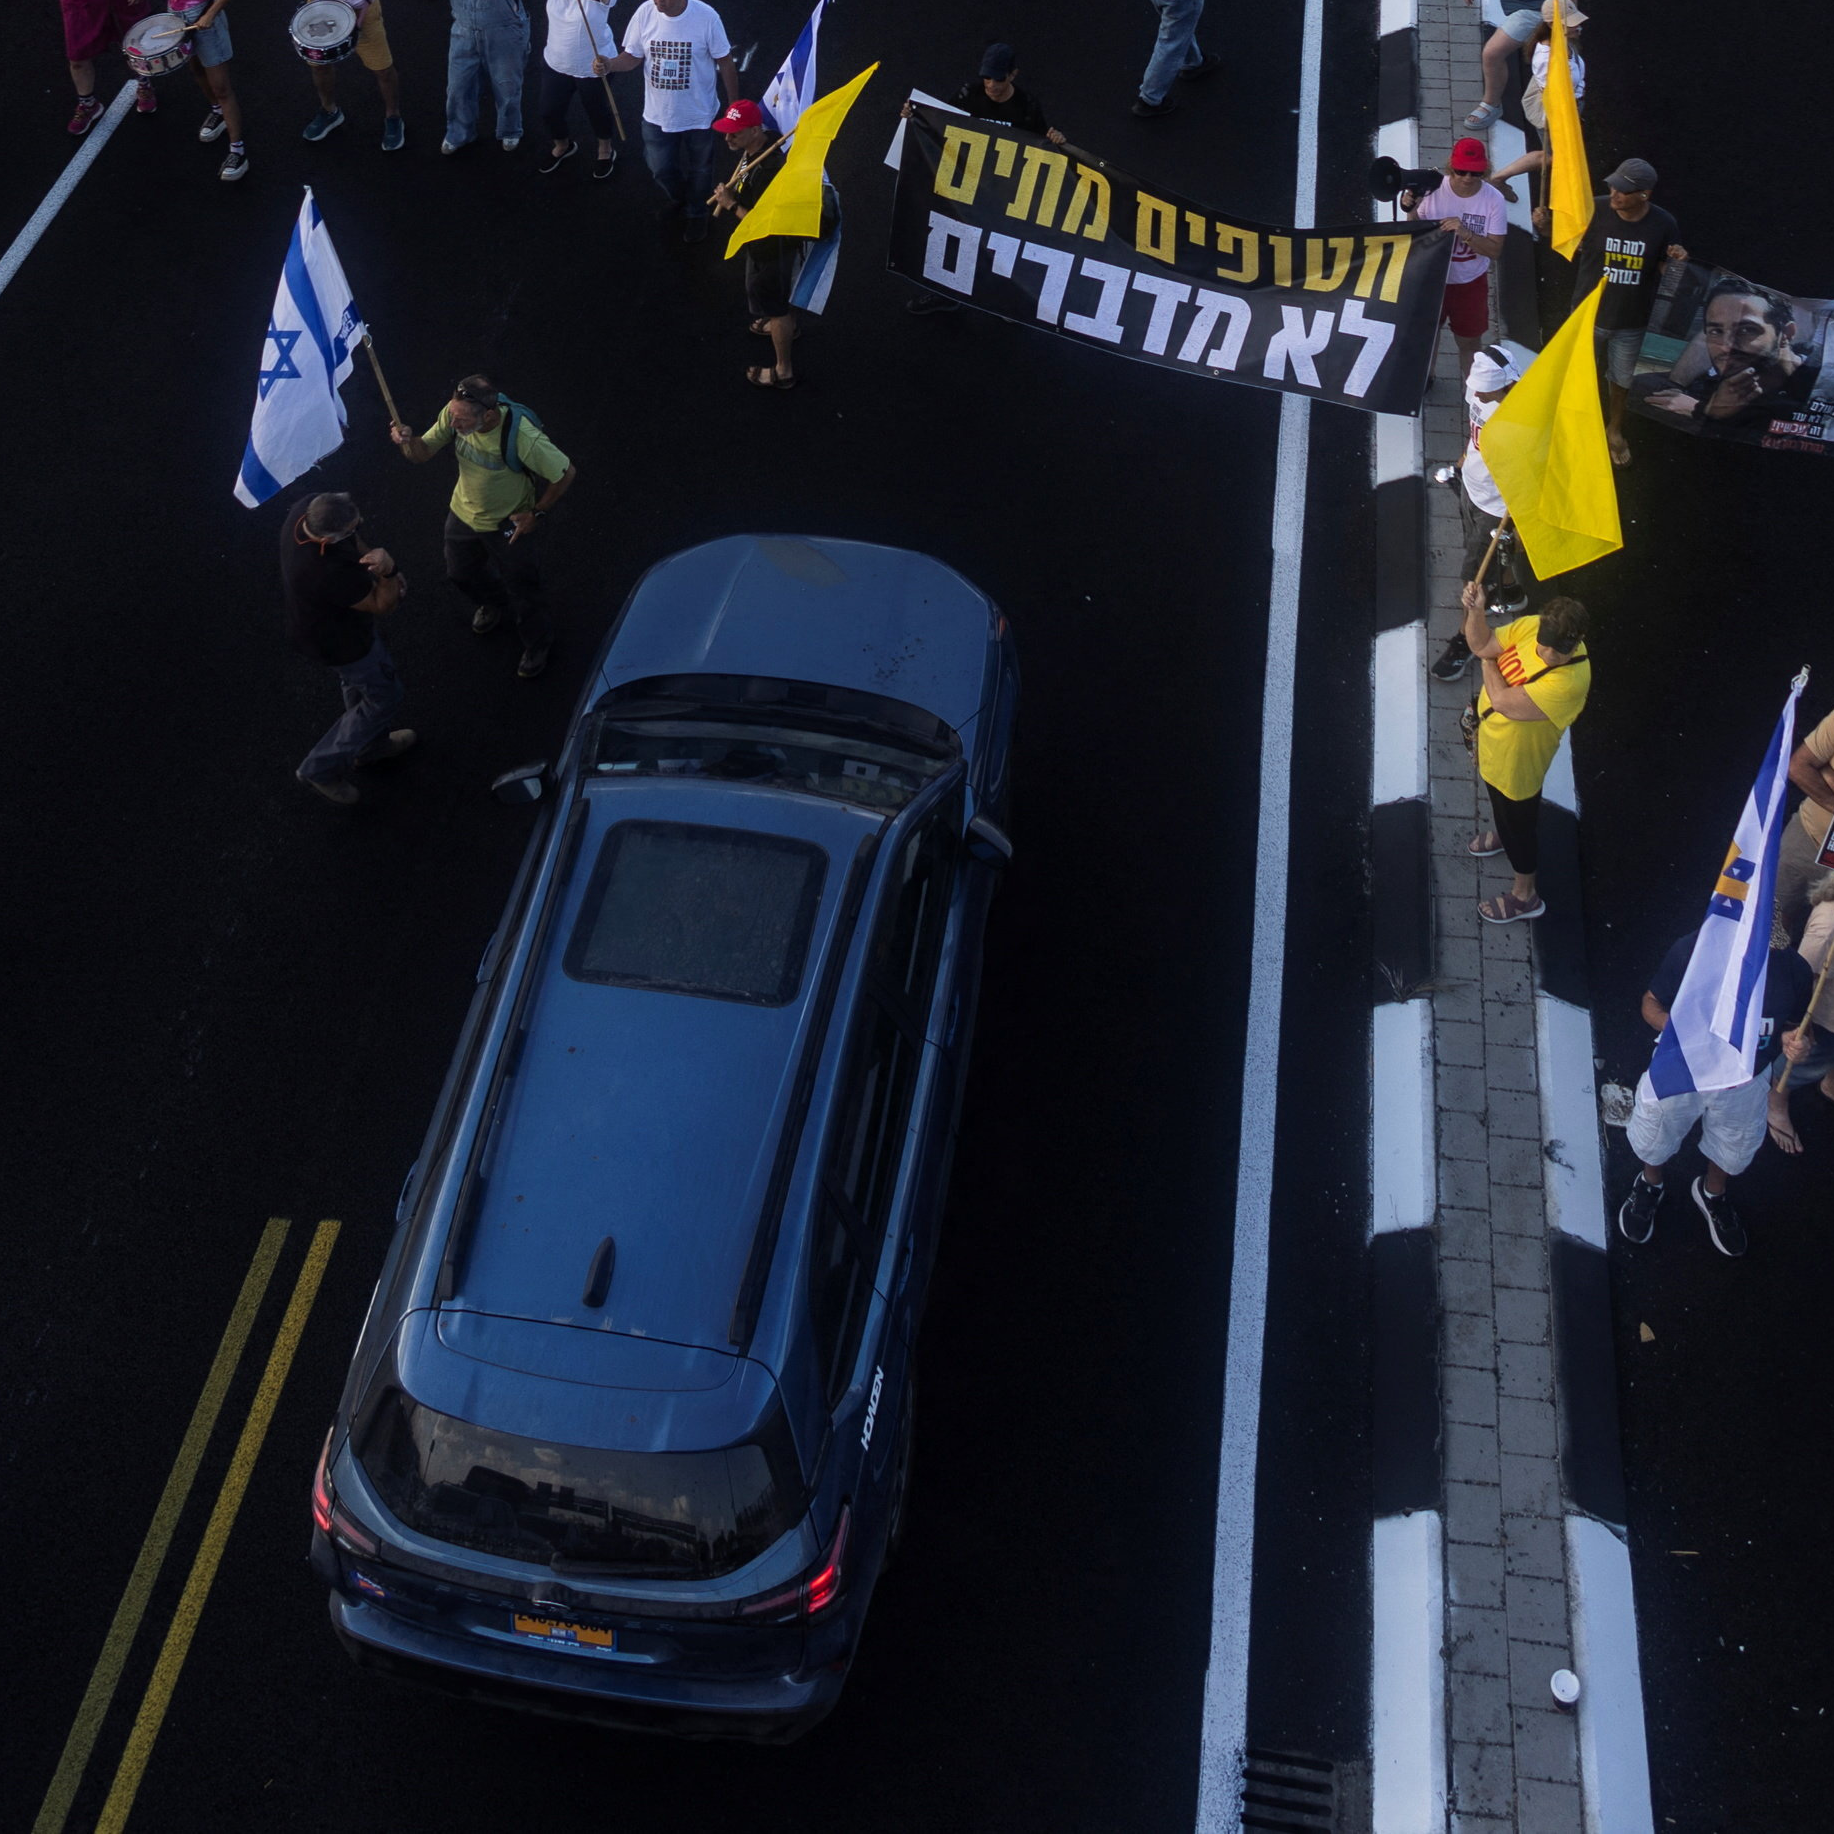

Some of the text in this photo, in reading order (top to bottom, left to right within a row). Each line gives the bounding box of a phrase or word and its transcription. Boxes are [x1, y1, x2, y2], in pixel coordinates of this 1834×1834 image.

[933, 124, 1412, 304] חטופים מתים
[1605, 237, 1646, 257] למה הם
[1604, 252, 1645, 271] עדיין
[1603, 266, 1642, 286] בעזה?
[922, 210, 1396, 398] לא מדברים
[1791, 411, 1821, 424] לא עוד
[1771, 419, 1822, 437] זה עכשיו!
[1496, 644, 1528, 689] NOW
[860, 1364, 886, 1452] HOWDEN
